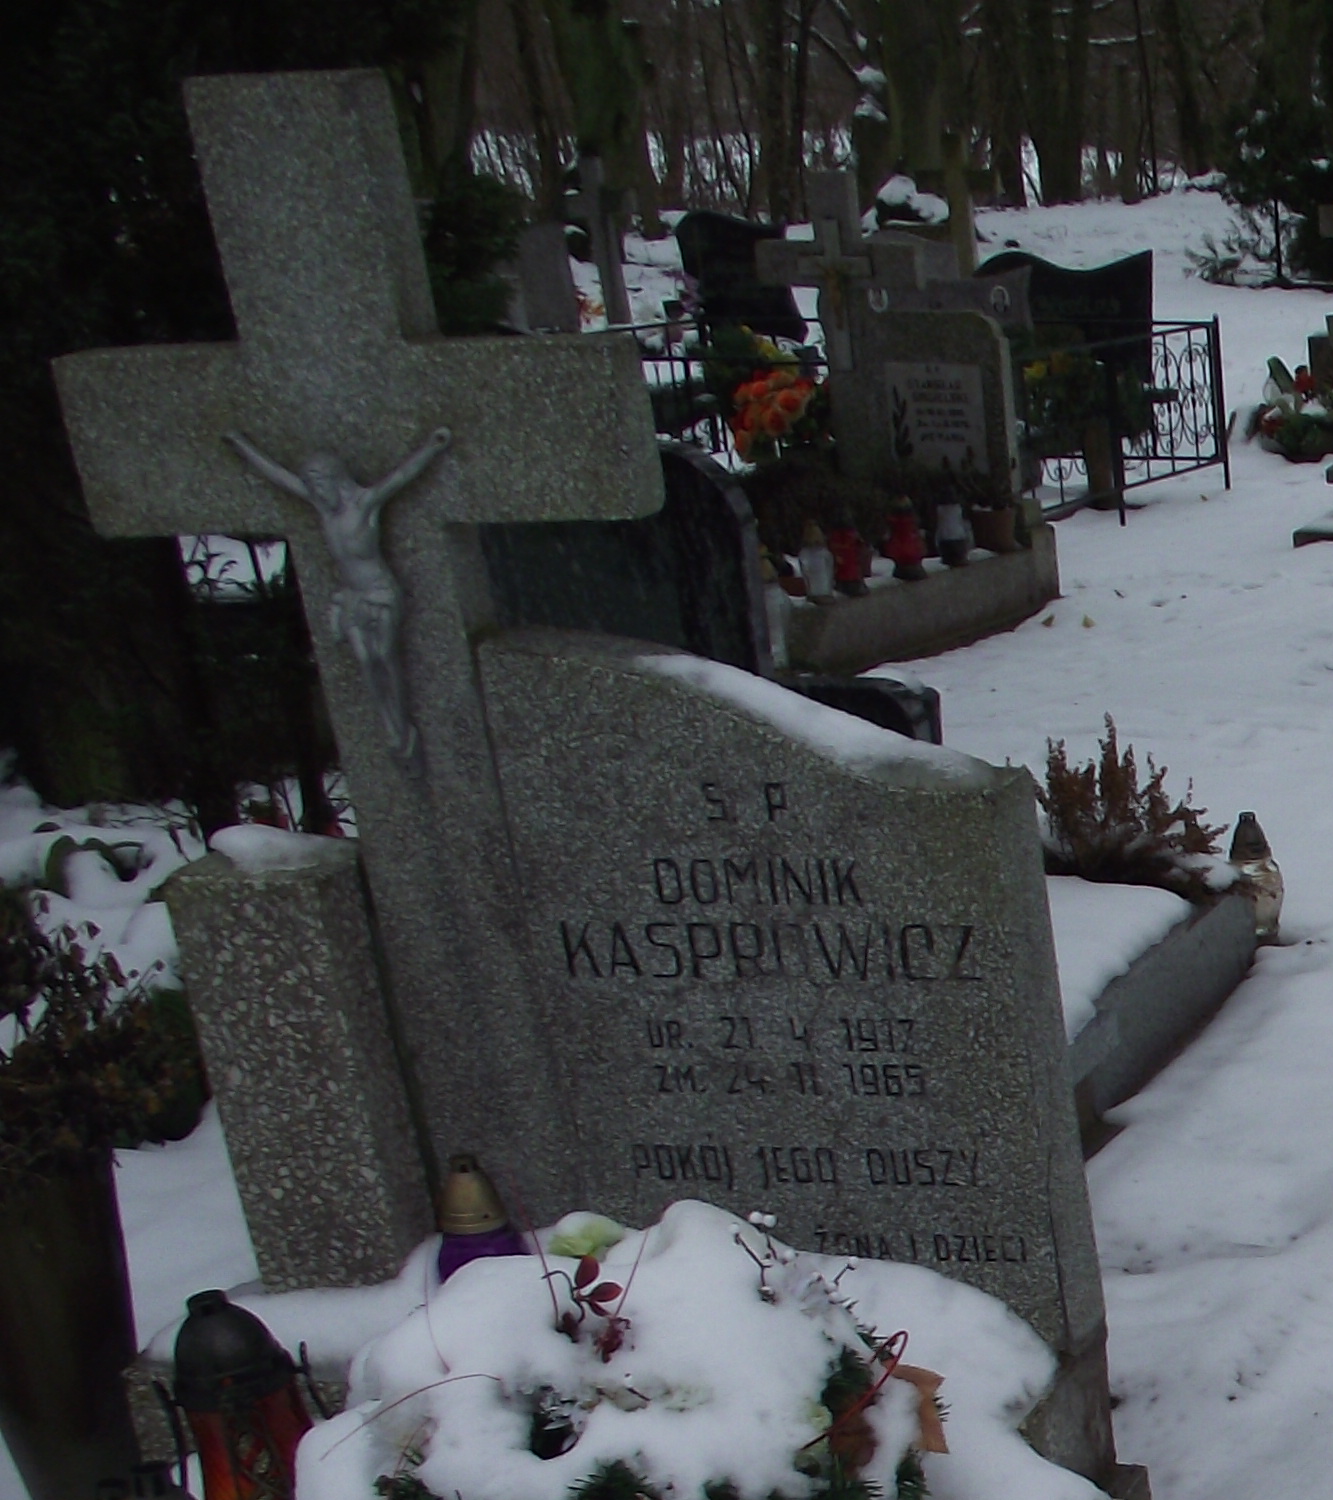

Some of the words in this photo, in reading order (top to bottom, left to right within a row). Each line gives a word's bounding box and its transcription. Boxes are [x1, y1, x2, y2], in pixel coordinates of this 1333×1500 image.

[652, 857, 863, 907] DOMINIK
[559, 919, 984, 983] KASPROWICZ
[646, 1017, 694, 1049] UR.
[653, 1064, 707, 1093] ZM.
[842, 1063, 926, 1097] 1965
[757, 1145, 839, 1190] JEGO
[866, 1147, 981, 1187] DUSZY
[932, 1232, 1028, 1263] DZIECI
